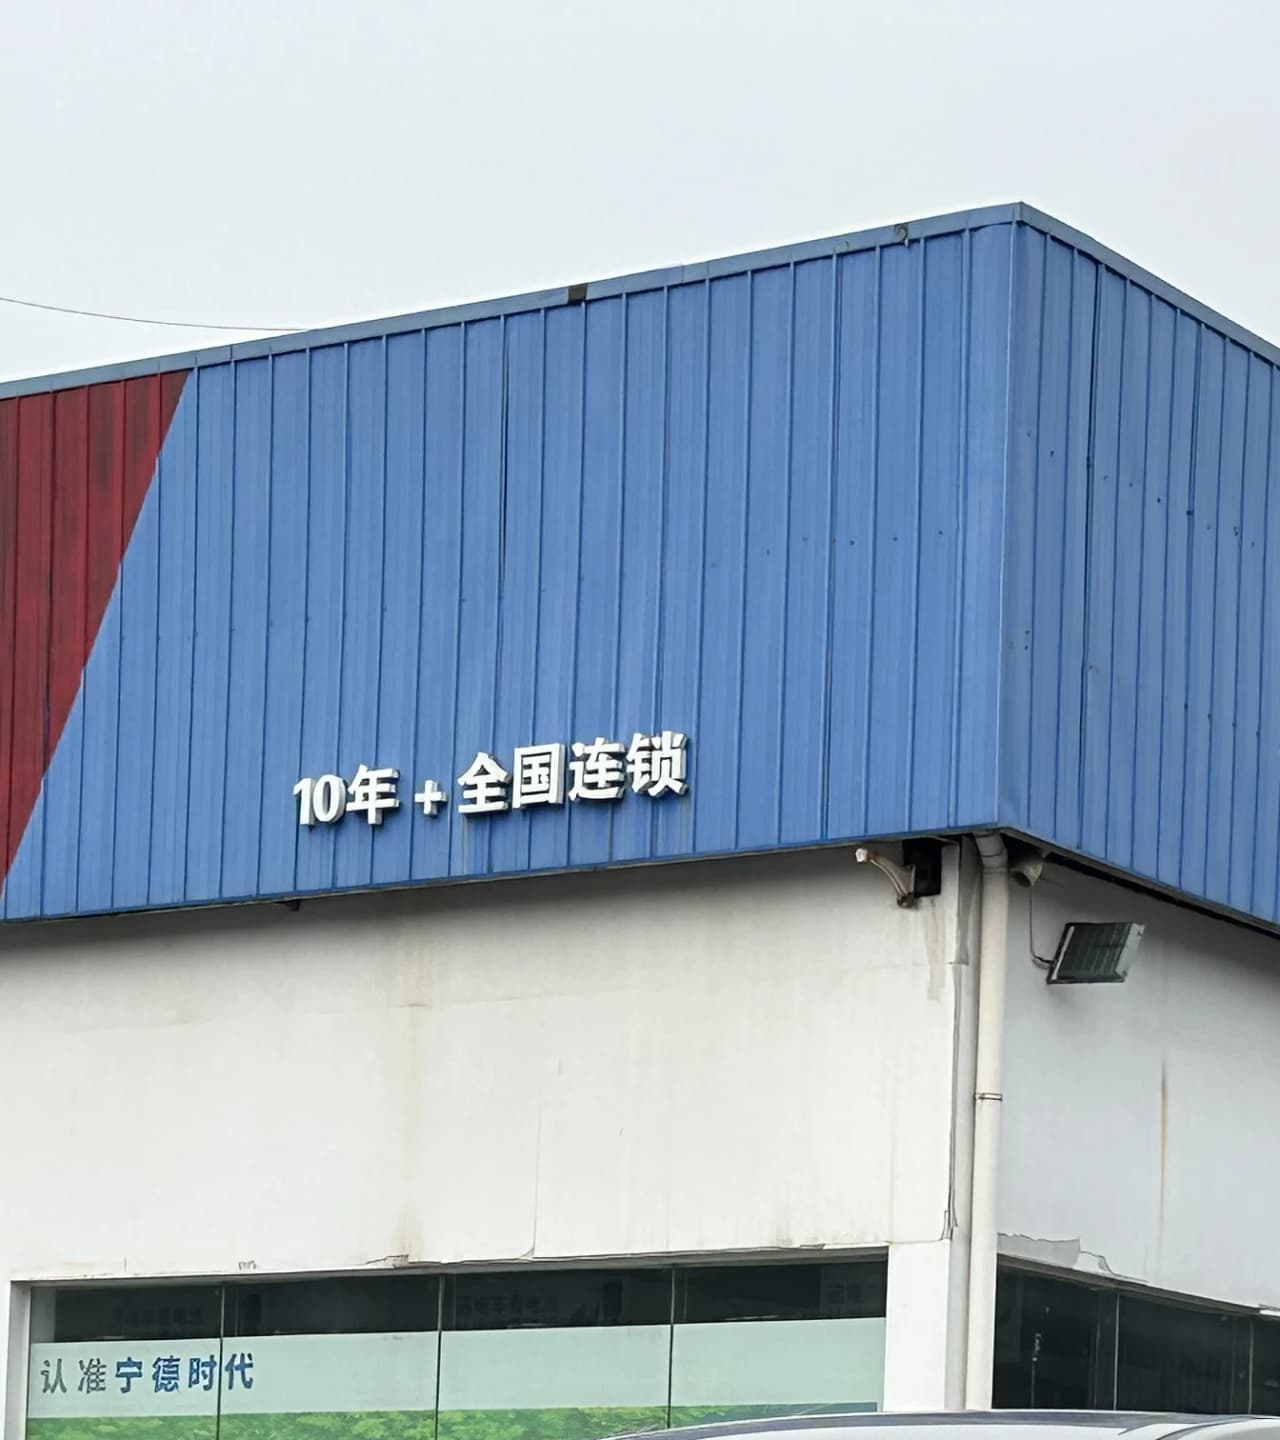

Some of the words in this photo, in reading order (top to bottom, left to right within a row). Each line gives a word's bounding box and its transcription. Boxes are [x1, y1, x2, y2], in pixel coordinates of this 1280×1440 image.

[293, 763, 399, 827] 10年
[457, 730, 689, 816] 全国连锁
[40, 1352, 254, 1395] 认准宁德时代
